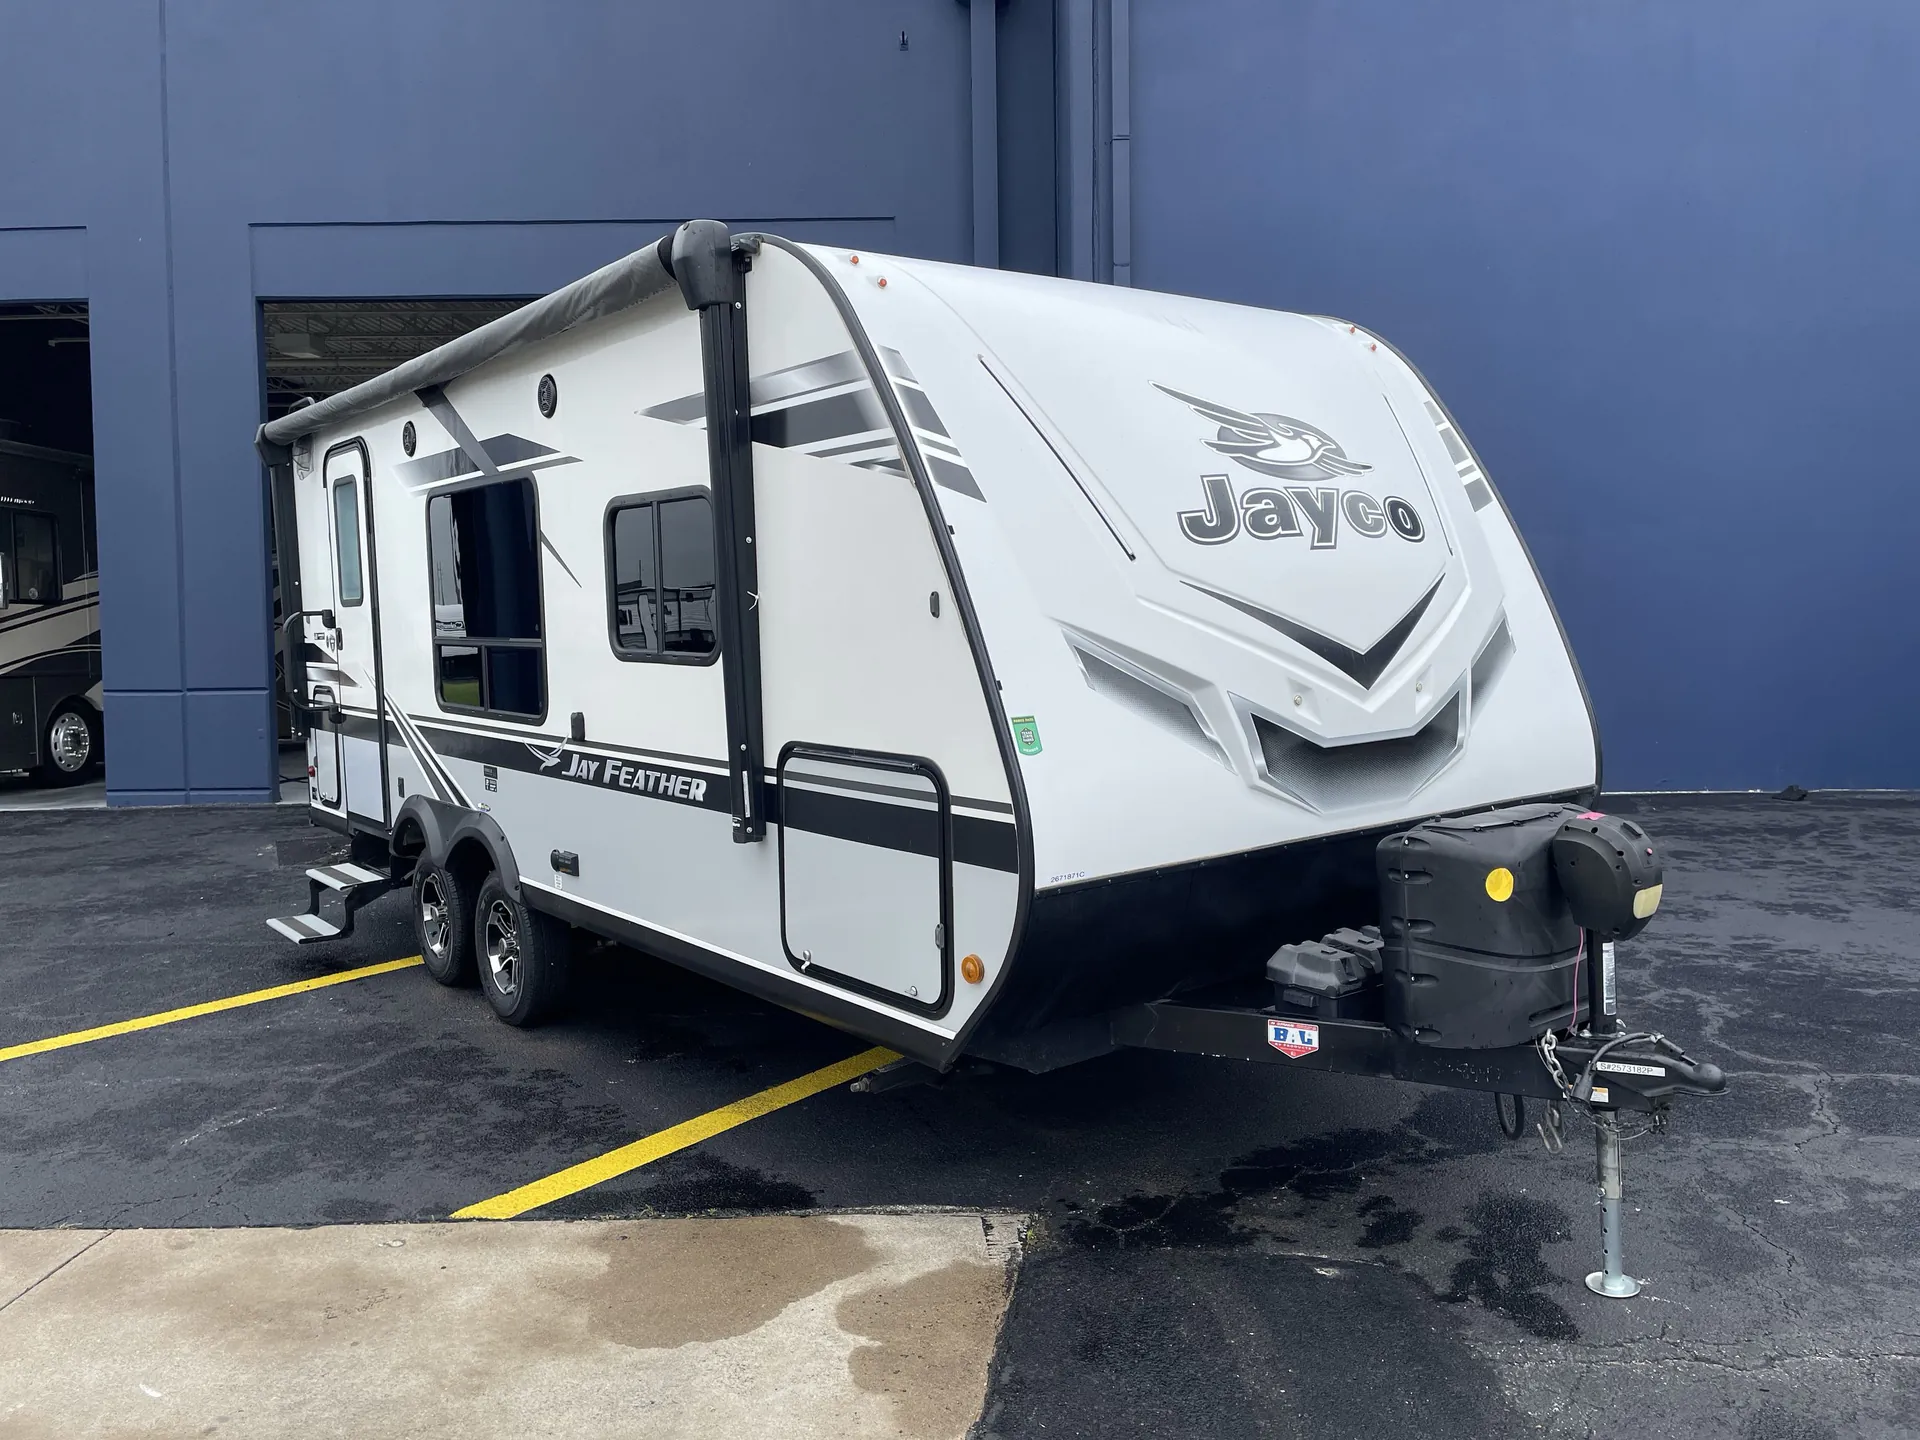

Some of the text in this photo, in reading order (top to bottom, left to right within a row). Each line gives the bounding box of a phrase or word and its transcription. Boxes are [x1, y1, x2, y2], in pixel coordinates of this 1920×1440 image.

[1177, 474, 1425, 550] Jayco
[561, 753, 600, 781] JAY
[603, 759, 707, 802] FEATHER
[1050, 871, 1085, 883] 2671871C
[1273, 1027, 1313, 1046] BAL
[1600, 1063, 1654, 1074] S#2573182P
